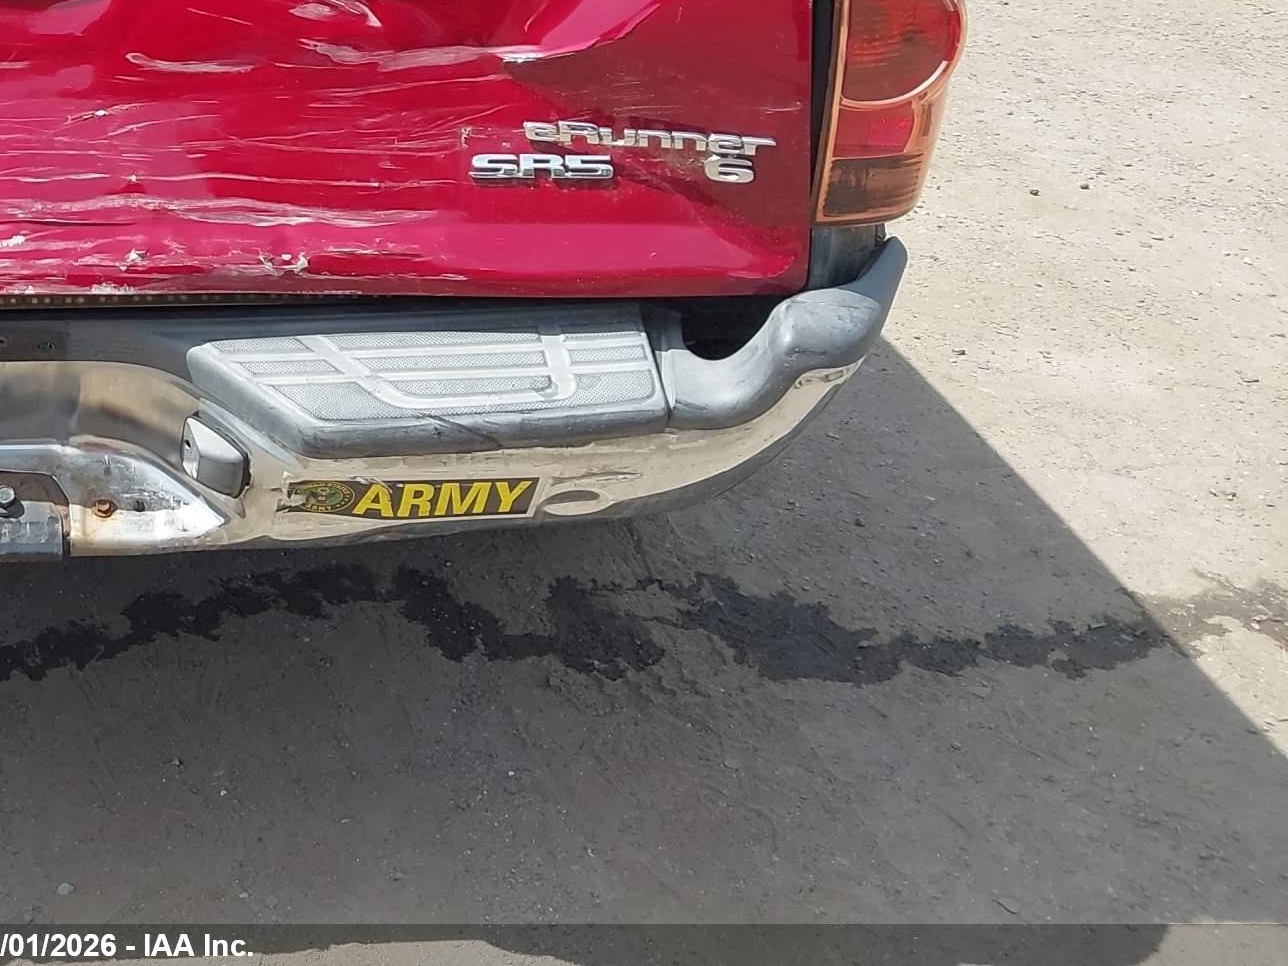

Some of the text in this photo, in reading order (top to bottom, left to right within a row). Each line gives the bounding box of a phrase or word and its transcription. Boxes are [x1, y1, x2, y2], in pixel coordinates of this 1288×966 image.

[523, 120, 776, 156] eRunner
[469, 153, 614, 179] SR5
[704, 155, 754, 183] 6
[352, 481, 532, 517] ARMY
